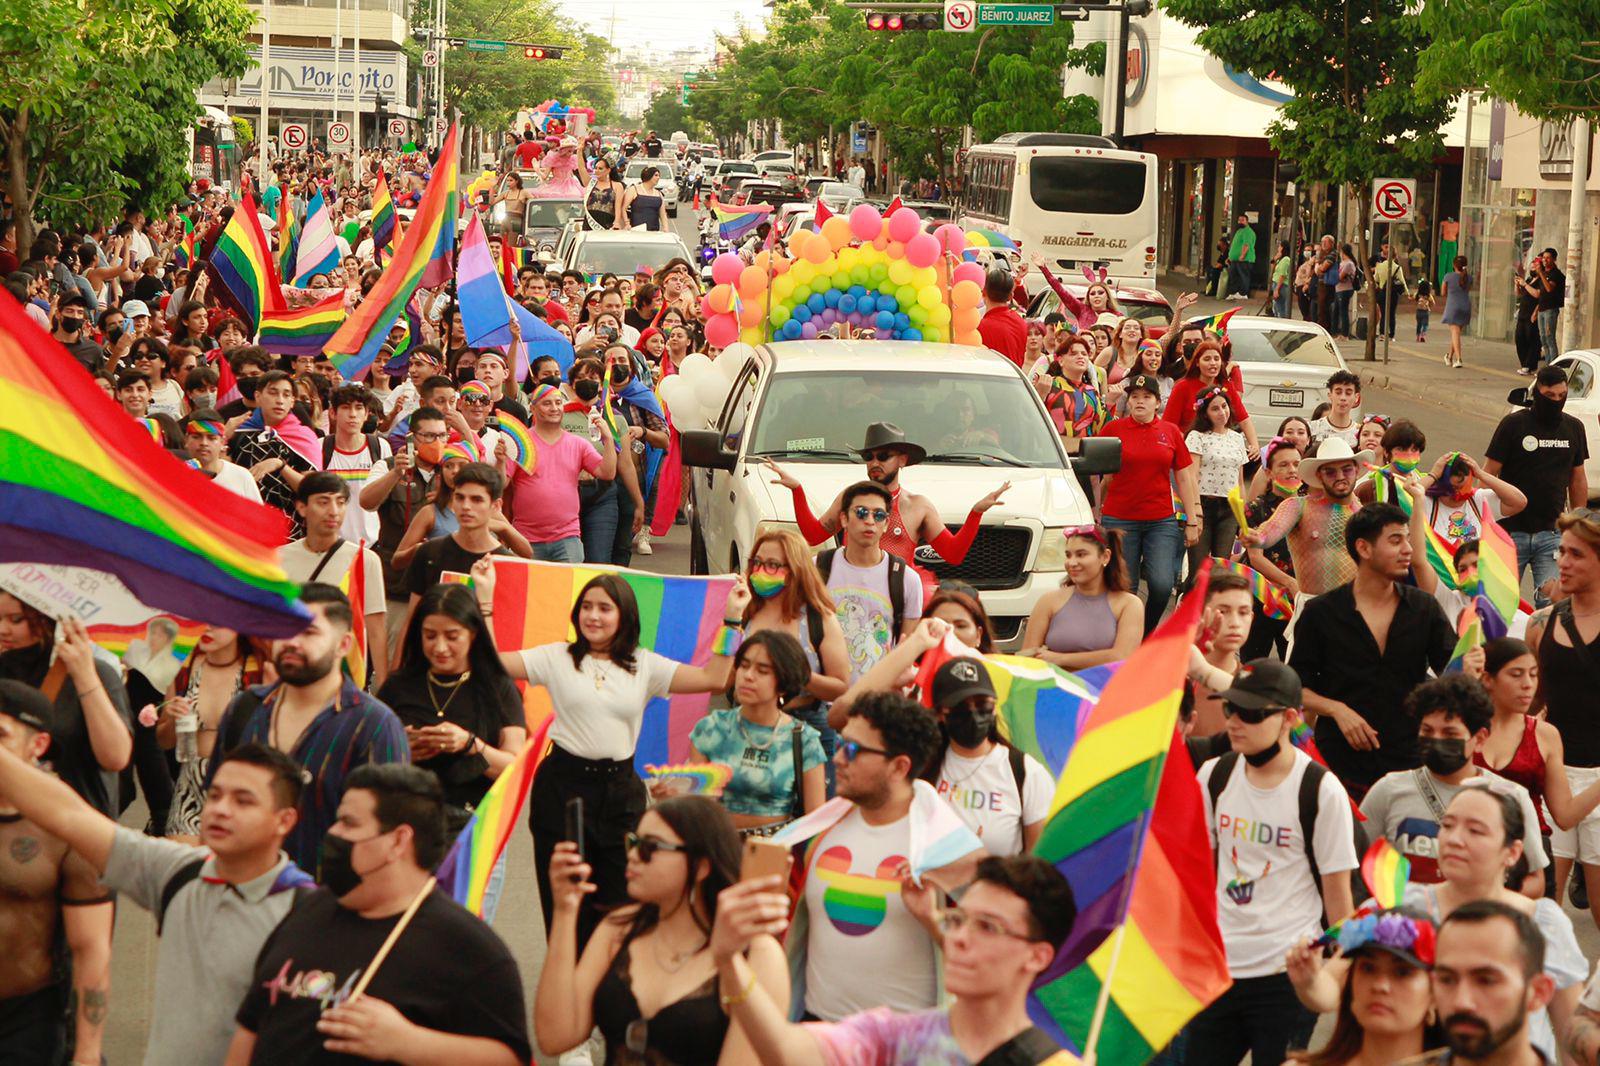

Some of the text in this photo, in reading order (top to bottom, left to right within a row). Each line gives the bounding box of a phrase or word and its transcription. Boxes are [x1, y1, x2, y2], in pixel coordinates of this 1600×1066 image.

[981, 10, 1051, 22] BENITO JUAREZ
[333, 127, 344, 137] 30
[937, 779, 1003, 812] PRIDE
[1219, 813, 1292, 848] PRIDE
